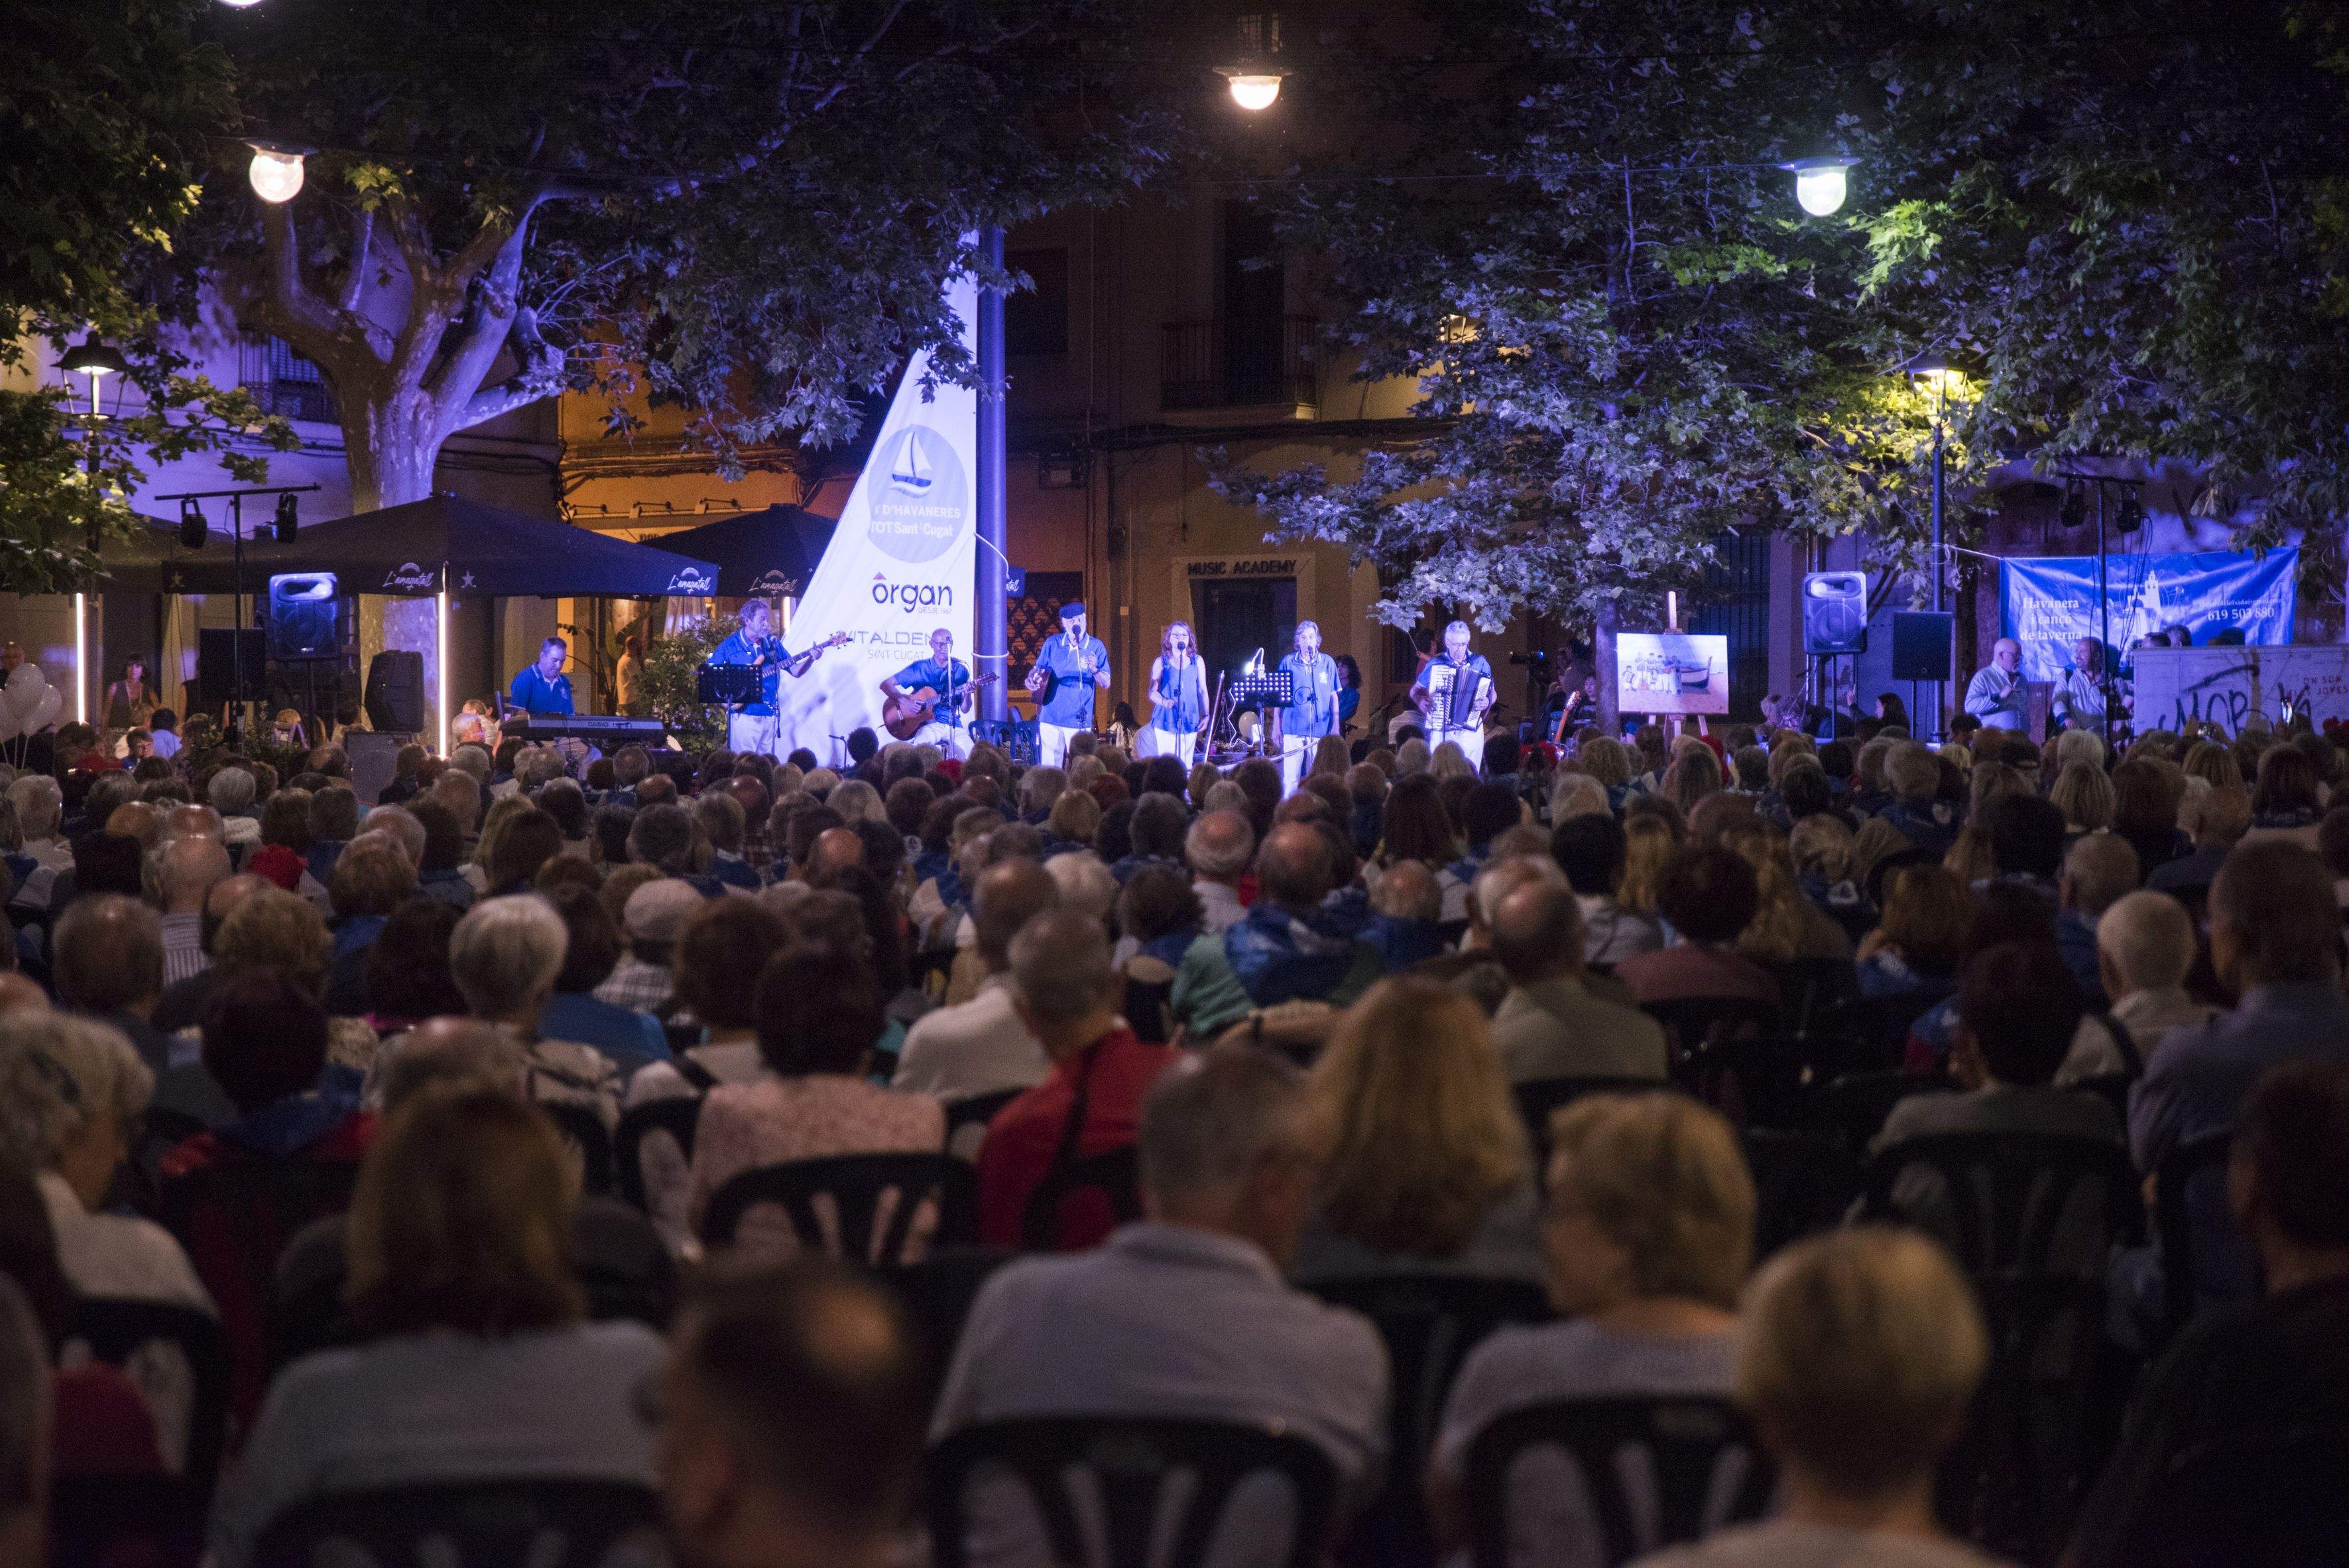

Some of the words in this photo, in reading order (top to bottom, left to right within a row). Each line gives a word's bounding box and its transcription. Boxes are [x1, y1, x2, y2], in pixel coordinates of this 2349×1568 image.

[882, 505, 961, 518] D'HAVANERES
[894, 521, 919, 534] Sant
[924, 522, 953, 538] Cugat
[1187, 562, 1227, 575] MUSIC
[1233, 559, 1297, 574] ACADEMY
[2023, 597, 2079, 609] Havanera
[2031, 613, 2035, 624] i
[2208, 610, 2228, 621] 619
[2232, 609, 2252, 619] 503
[2255, 607, 2275, 619] 880
[2019, 629, 2035, 640] de
[2038, 630, 2082, 640] taverna
[894, 650, 926, 660] CUGAT
